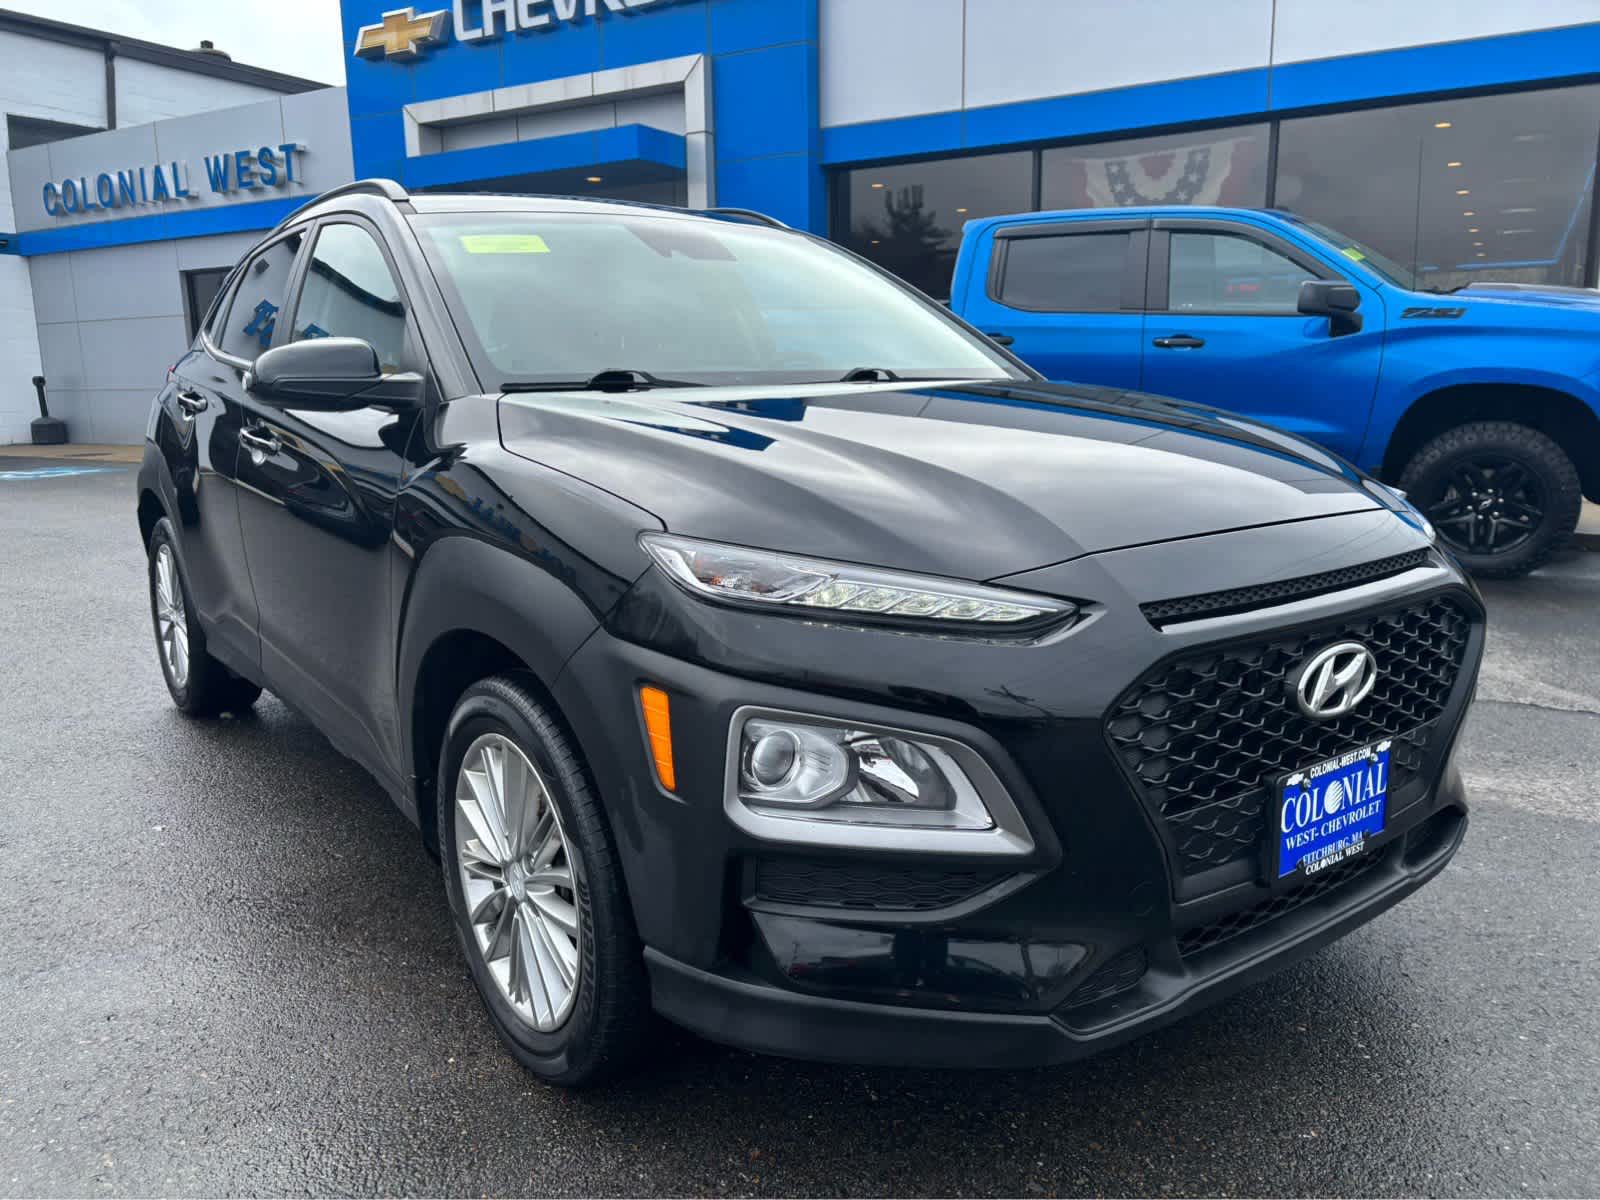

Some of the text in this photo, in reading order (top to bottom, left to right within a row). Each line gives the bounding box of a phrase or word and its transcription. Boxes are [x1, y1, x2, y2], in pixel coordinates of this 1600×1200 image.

[42, 143, 300, 217] COLONIAL WEST
[1310, 747, 1371, 779] COLONIAL-WEST.COM
[1281, 763, 1387, 833] COLONIAL
[1321, 800, 1381, 837] CHEVROLET
[1305, 841, 1365, 875] COLONIAL WEST
